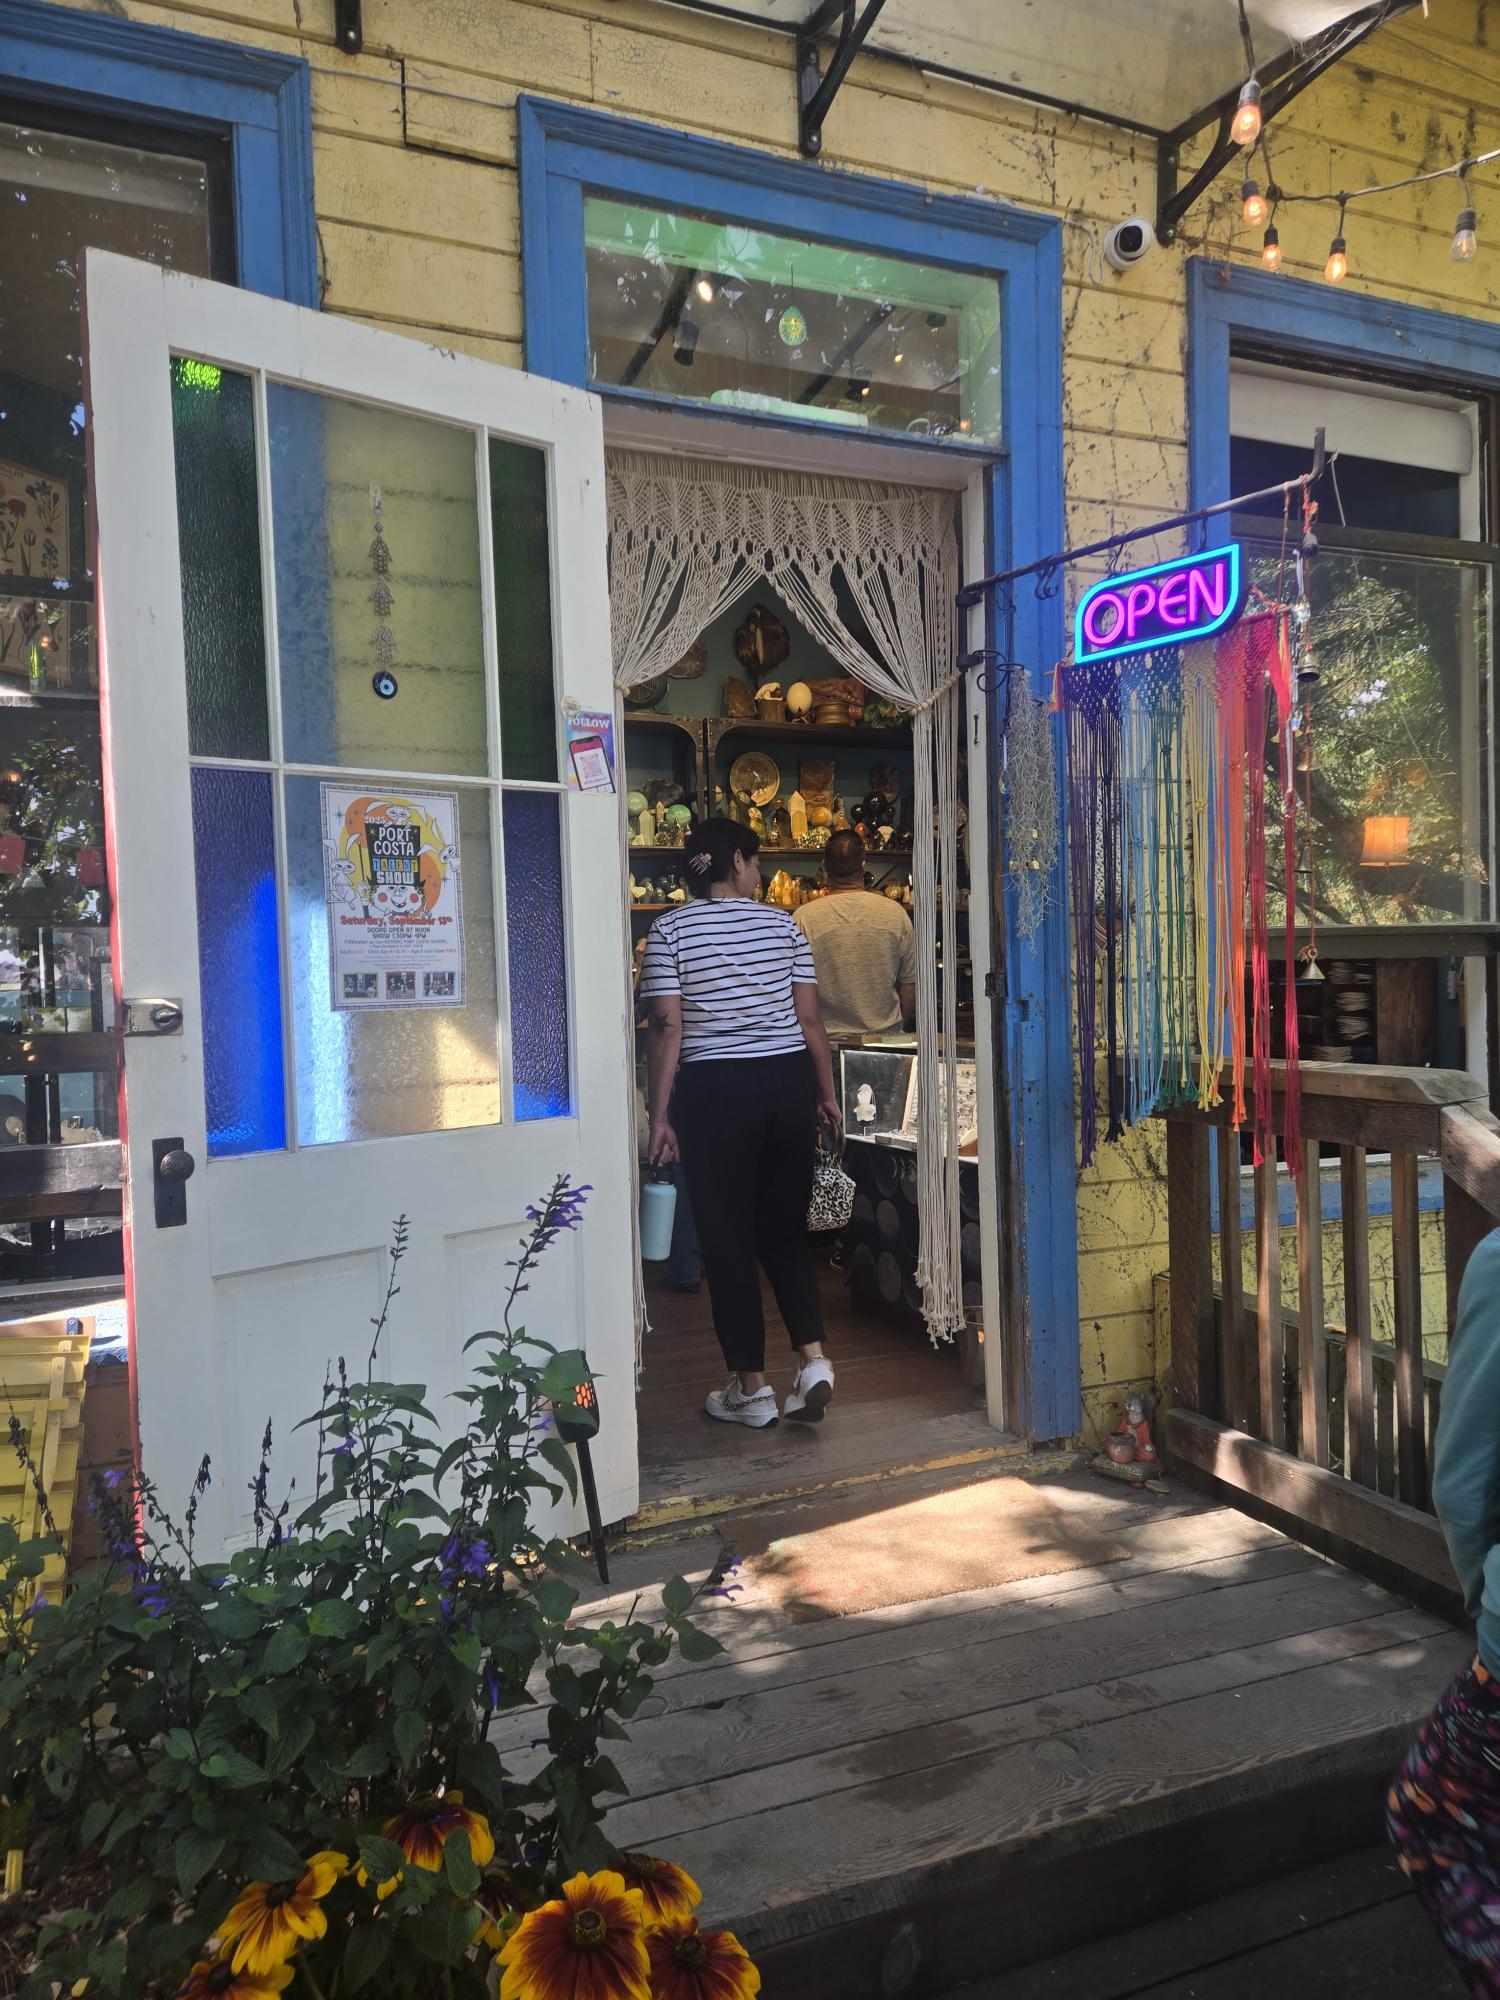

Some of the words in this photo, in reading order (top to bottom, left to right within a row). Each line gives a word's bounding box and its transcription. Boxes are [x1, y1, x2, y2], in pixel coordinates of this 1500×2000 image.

[1084, 562, 1224, 644] OPEN
[567, 718, 610, 729] FOLLOW
[379, 827, 411, 841] PORT
[373, 841, 414, 856] COSTA
[373, 859, 418, 872] TALENT
[376, 872, 414, 884] SHOW
[388, 915, 436, 927] September
